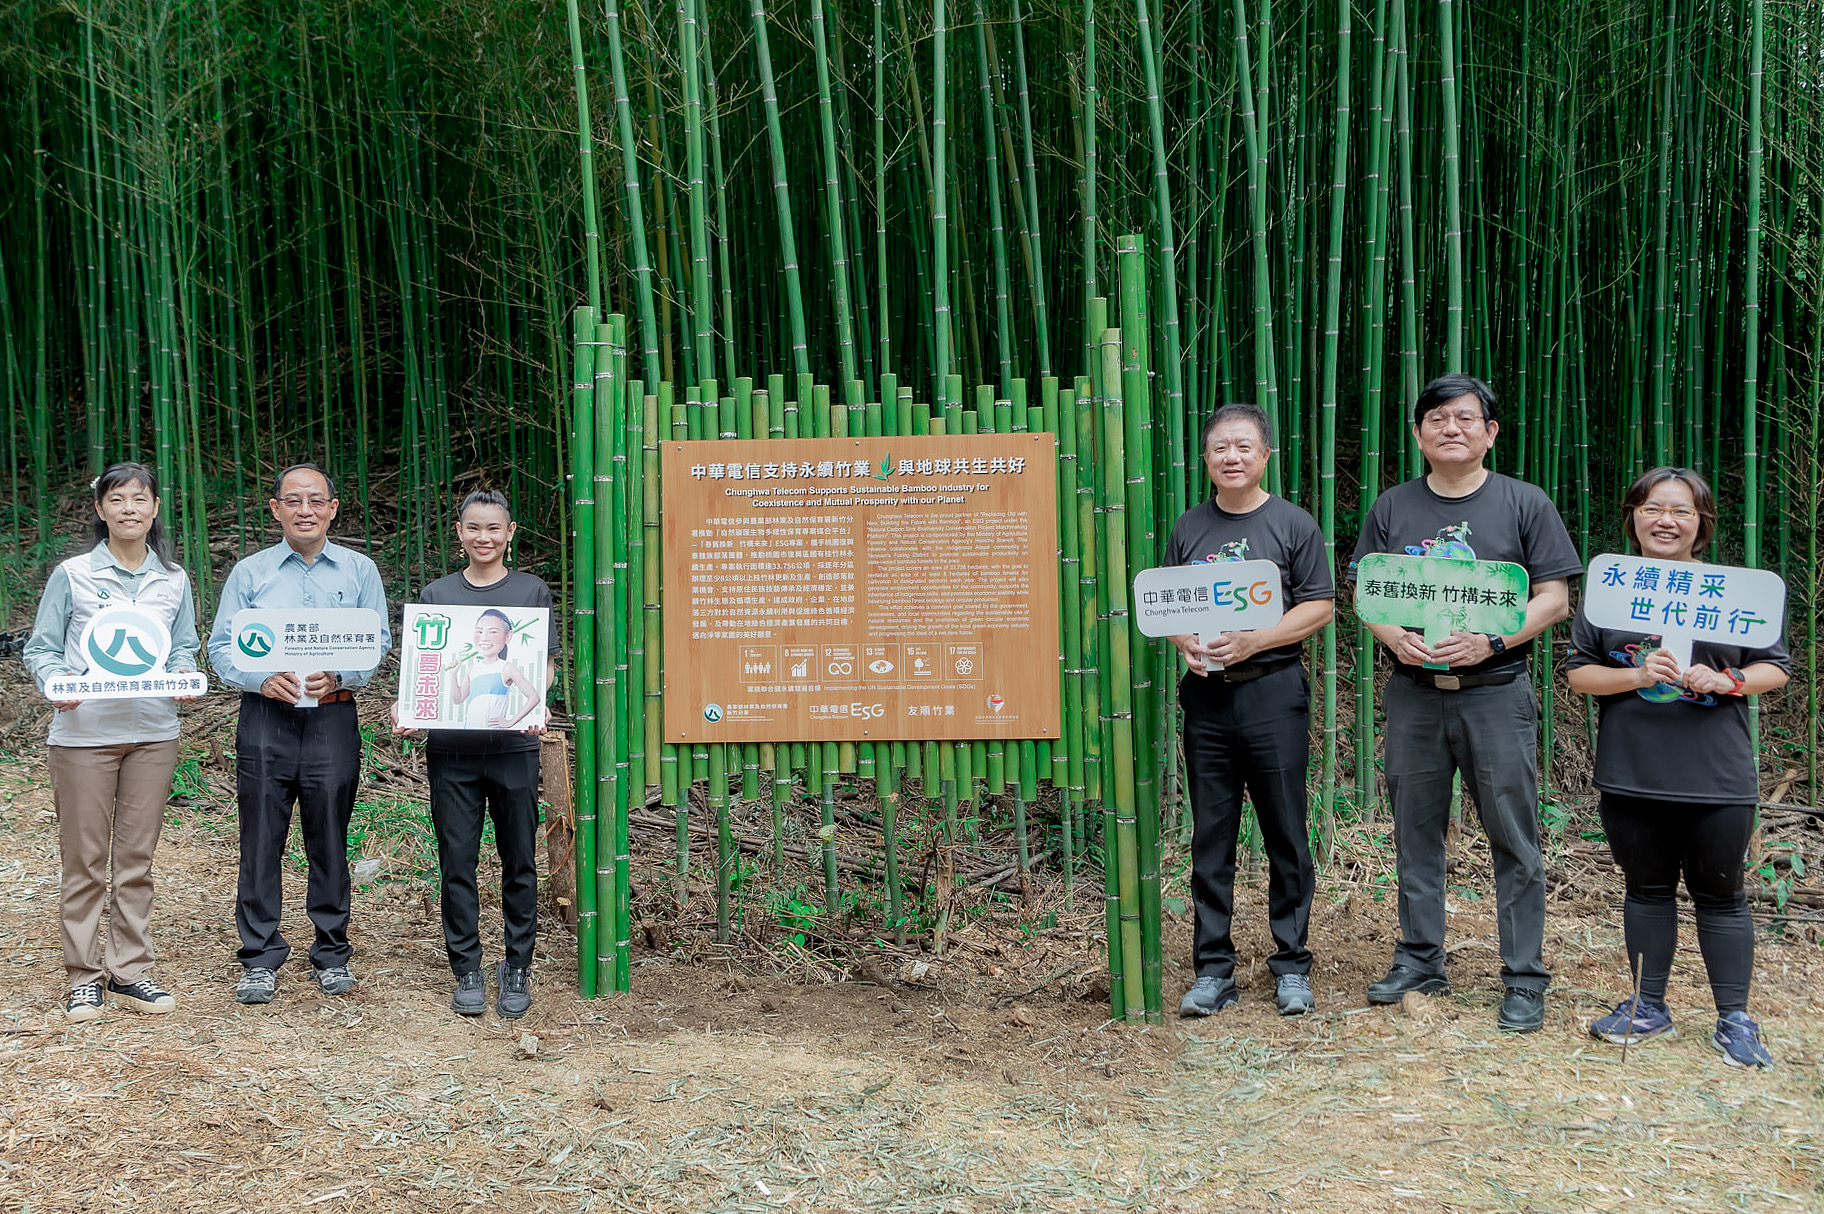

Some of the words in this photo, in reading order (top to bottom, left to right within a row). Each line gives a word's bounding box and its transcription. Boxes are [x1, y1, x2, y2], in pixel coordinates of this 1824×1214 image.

[691, 460, 870, 480] 中華電信支持永續竹業
[898, 457, 1025, 475] 與地球共生共好
[725, 488, 770, 497] Chunghwa
[809, 486, 848, 495] Supports
[850, 485, 899, 494] Sustainable
[939, 484, 974, 493] Industry
[752, 499, 804, 508] Coexistence
[855, 497, 898, 506] Prosperity
[937, 495, 964, 504] Planet
[1602, 563, 1725, 598] 永續精采
[1144, 586, 1208, 605] 中華電信
[1214, 581, 1272, 611] ESG
[1365, 580, 1436, 601] 泰舊換新
[1442, 585, 1517, 607] 竹構未來
[1145, 608, 1180, 617] Chunghwa
[1182, 606, 1210, 614] Telecom
[1631, 597, 1762, 634] 世代前行
[285, 624, 319, 632] 農業部
[284, 634, 375, 644] 林業及自然保育署
[52, 679, 200, 694] 林業及自然保育署新竹分署
[810, 705, 848, 714] 中華電信
[851, 703, 885, 720] ESG
[908, 705, 955, 716] 友順竹業
